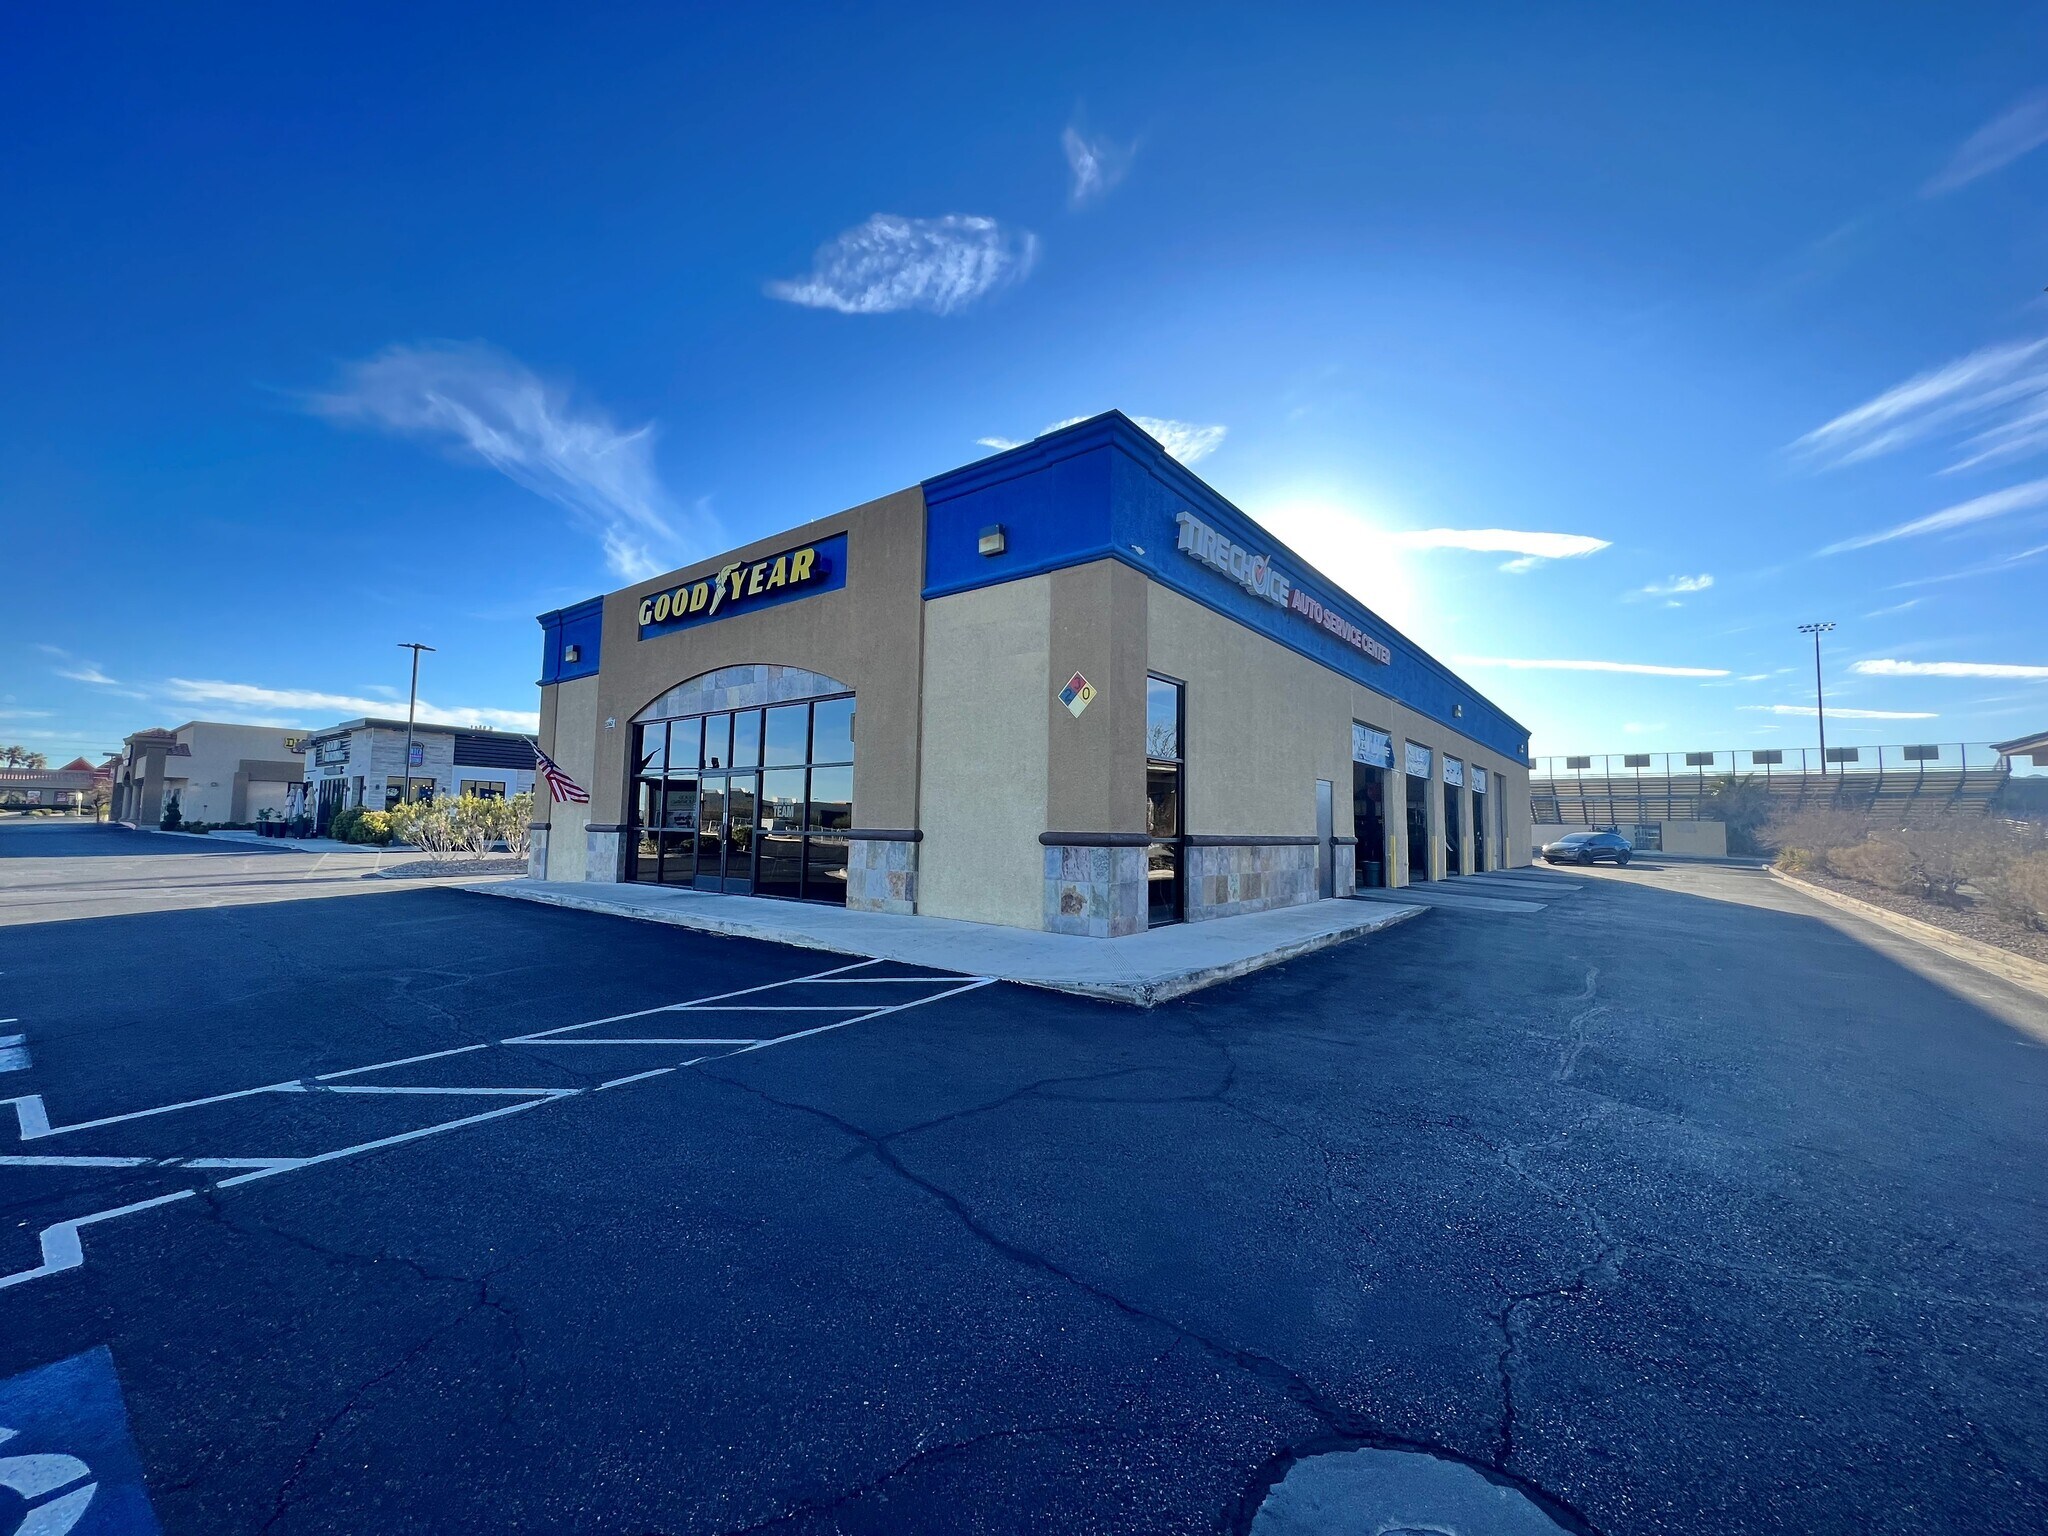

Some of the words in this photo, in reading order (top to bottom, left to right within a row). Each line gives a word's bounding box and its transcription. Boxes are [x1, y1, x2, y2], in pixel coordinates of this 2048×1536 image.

[1291, 589, 1323, 624] AUTO
[1323, 608, 1362, 648] SERVICE
[1361, 633, 1391, 666] CENTER
[773, 806, 794, 818] TEAM
